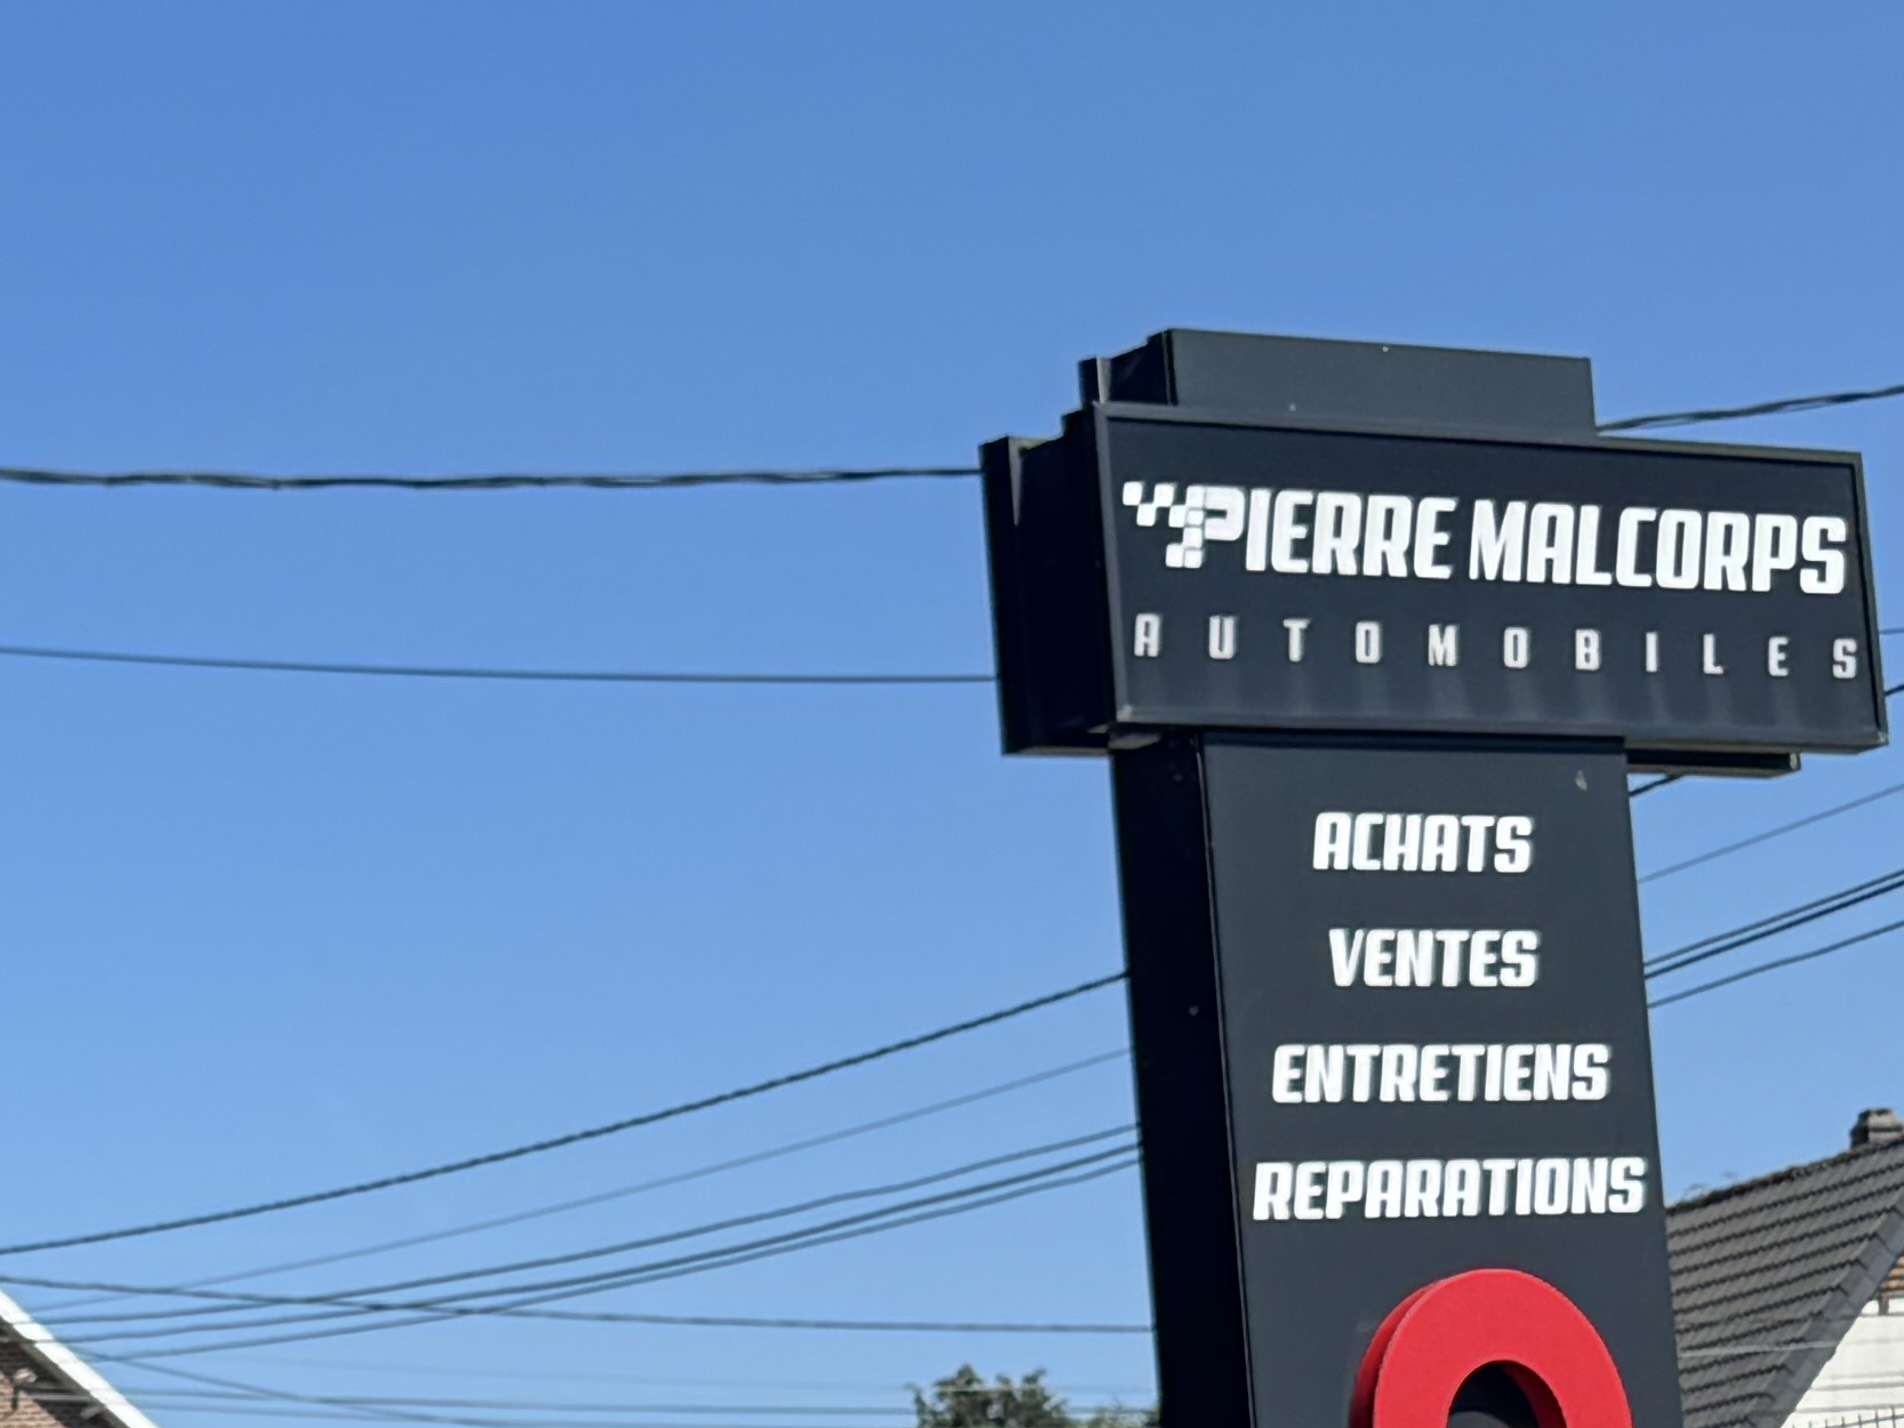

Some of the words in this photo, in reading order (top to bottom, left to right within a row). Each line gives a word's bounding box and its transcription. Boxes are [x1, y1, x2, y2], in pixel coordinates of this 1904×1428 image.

[1164, 482, 1458, 580] PIERRE
[1468, 499, 1848, 595] MALCORPS
[1133, 612, 1858, 680] AUTOMOBILES
[1311, 811, 1536, 873] ACHATS
[1328, 928, 1542, 988] VENTES
[1271, 1043, 1612, 1104] ENTRETIENS
[1252, 1156, 1649, 1221] REPARATIONS
